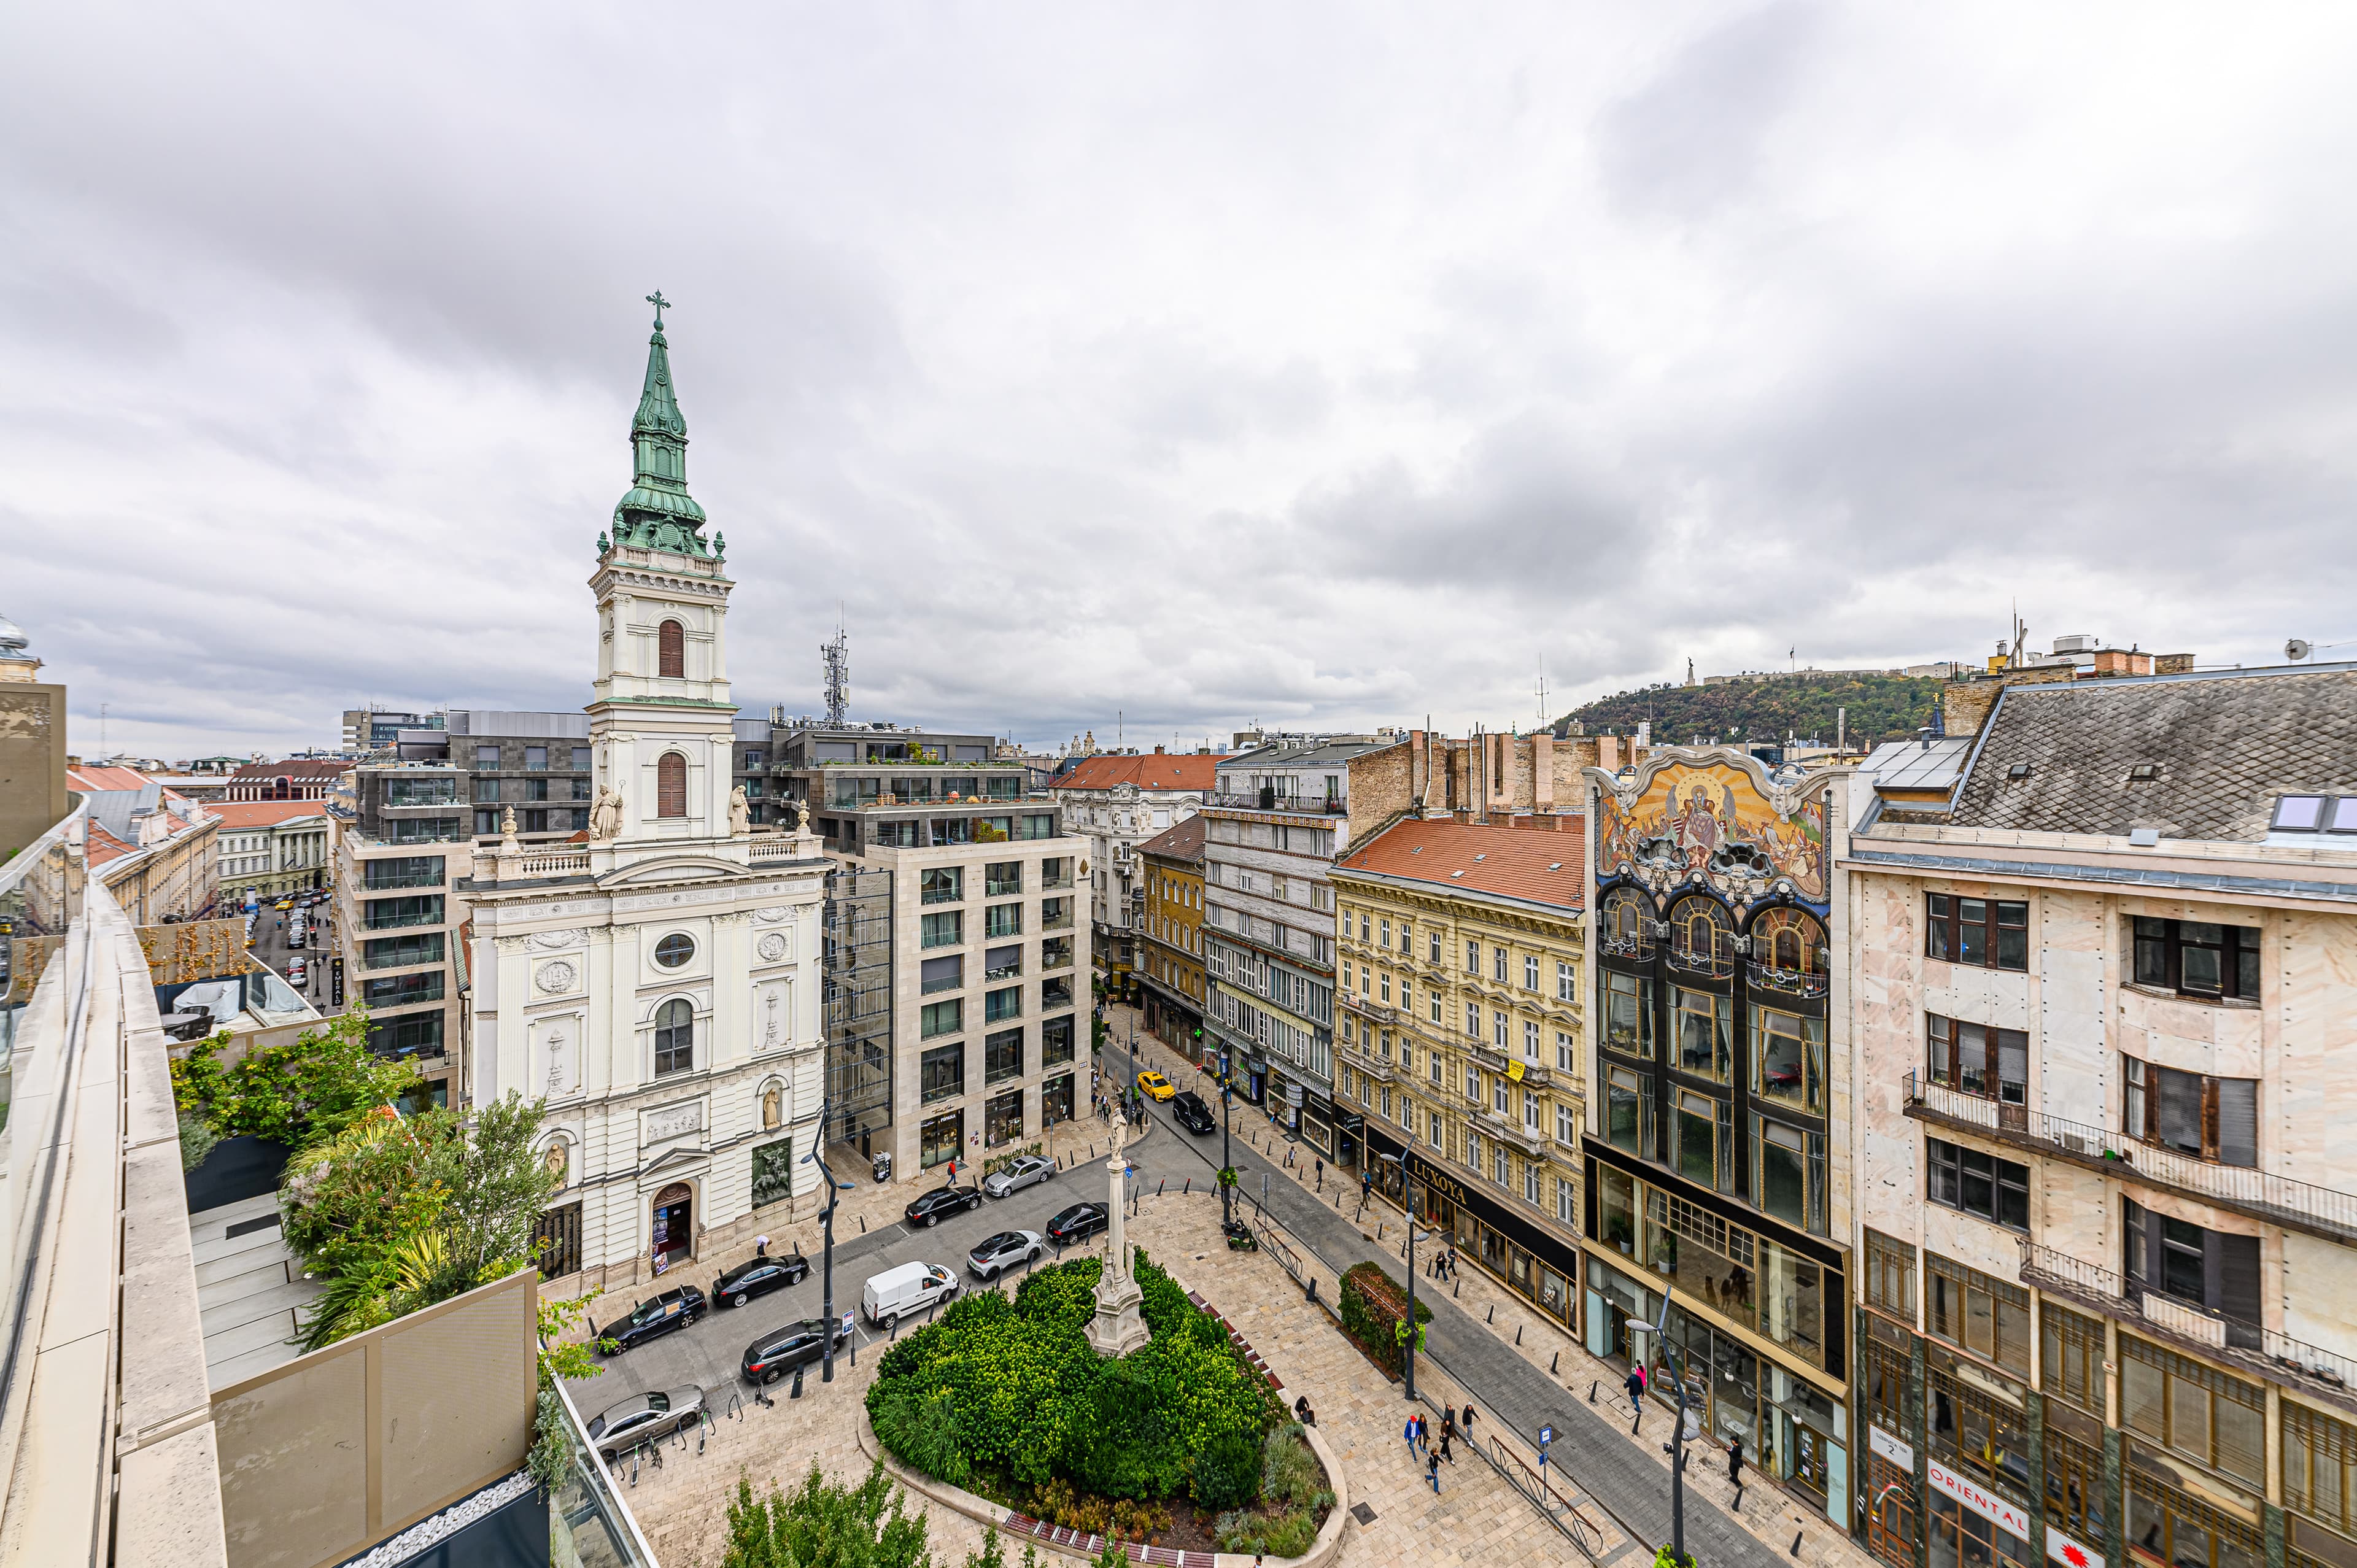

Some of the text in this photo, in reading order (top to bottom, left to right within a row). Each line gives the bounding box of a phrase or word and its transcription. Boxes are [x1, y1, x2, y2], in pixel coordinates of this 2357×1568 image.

[546, 968, 568, 983] IHS
[1253, 998, 1272, 1014] SZALON
[1277, 1010, 1285, 1020] Arts
[1291, 1016, 1304, 1030] Café
[1414, 1159, 1467, 1205] LUXOYA
[1888, 1445, 1894, 1456] 2
[1930, 1468, 2026, 1532] ORIENTAL
